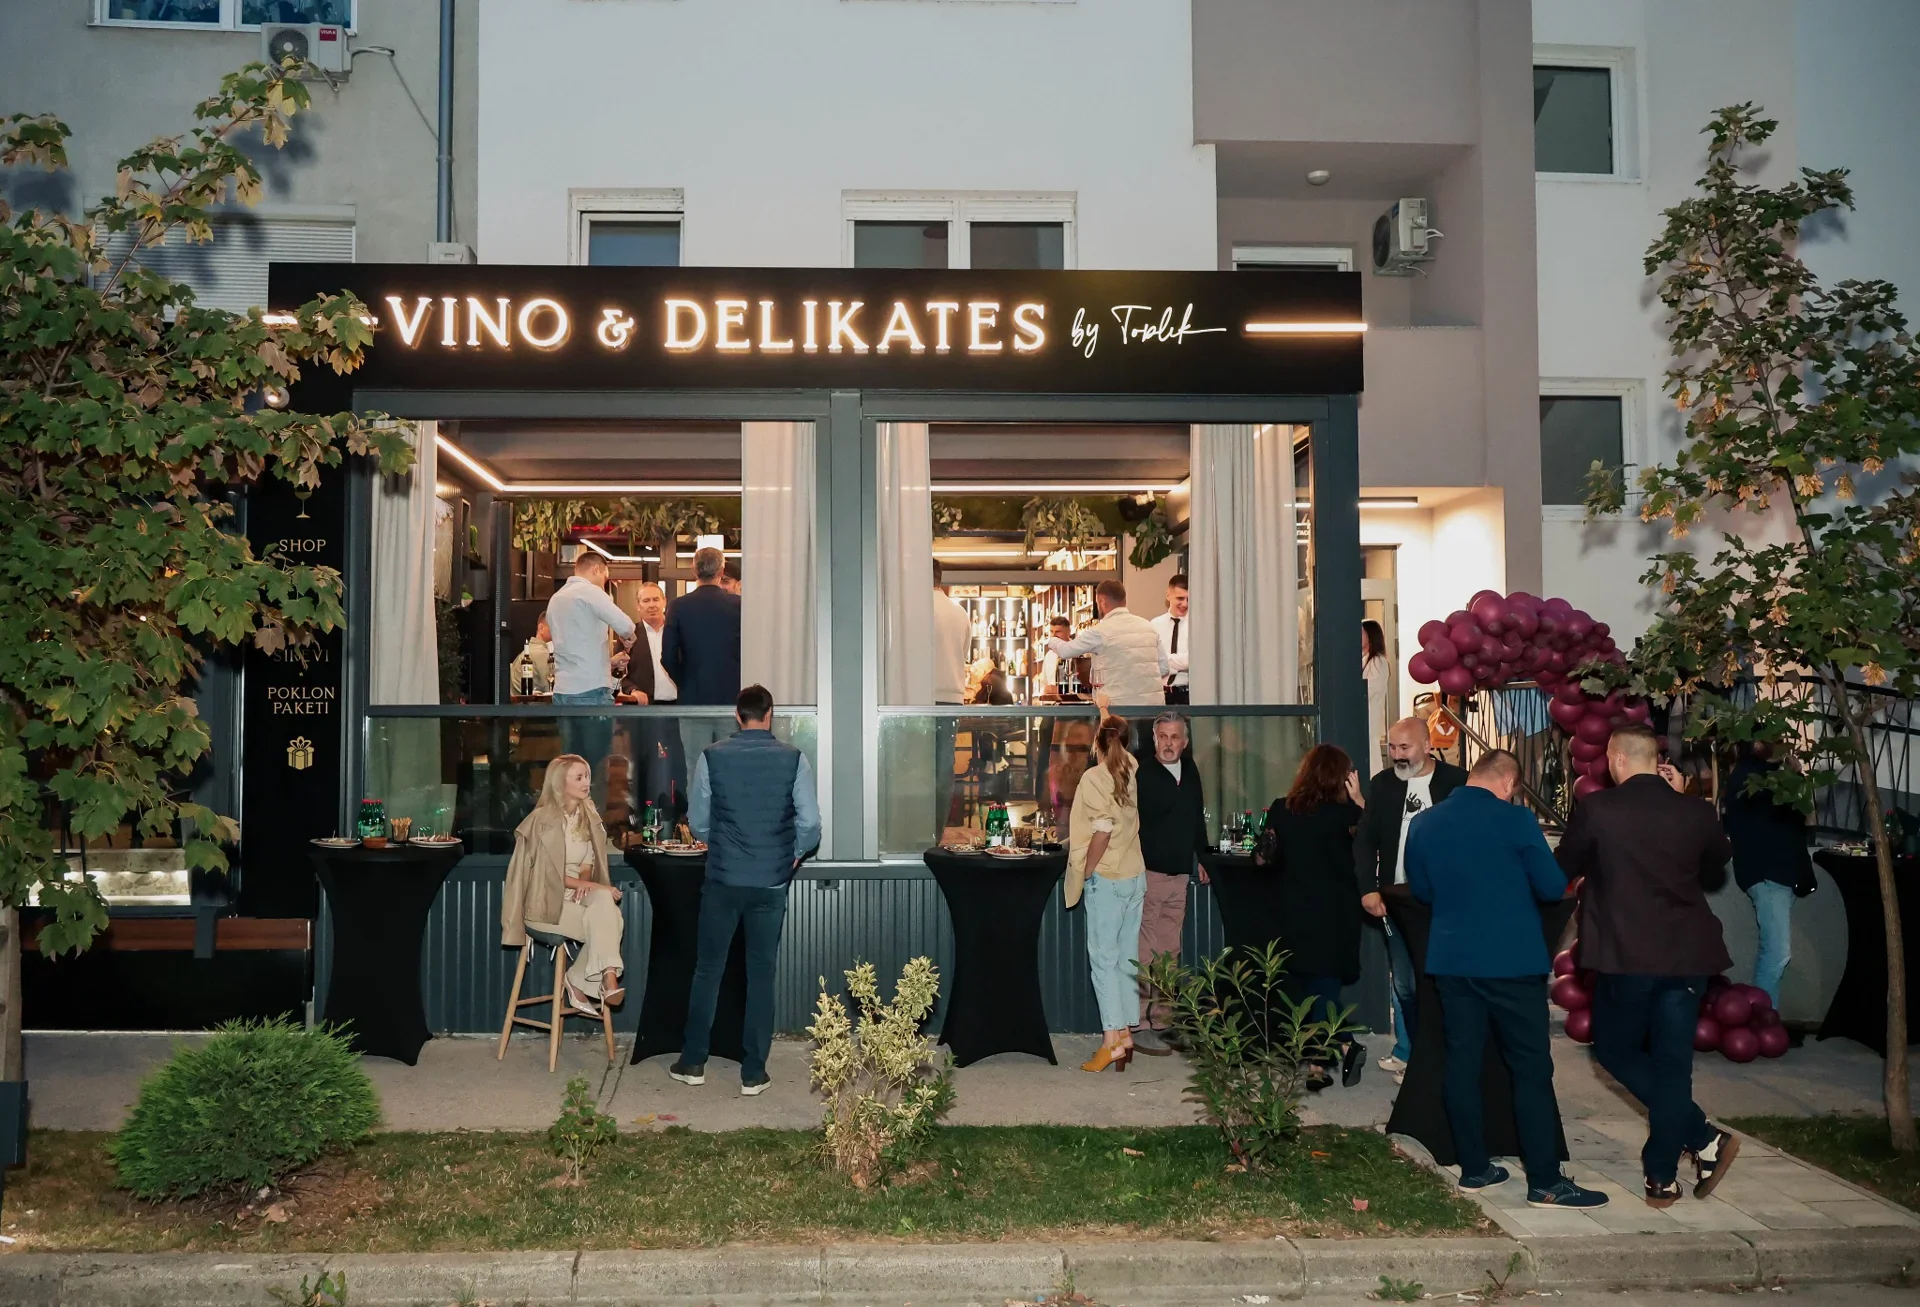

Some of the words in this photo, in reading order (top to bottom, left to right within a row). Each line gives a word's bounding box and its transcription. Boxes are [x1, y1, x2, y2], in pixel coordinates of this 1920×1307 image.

[385, 296, 571, 349] VINO
[597, 309, 635, 349] &
[664, 299, 1046, 353] DELIKATES
[1071, 307, 1100, 359] by
[278, 538, 327, 553] SHOP
[267, 686, 335, 700] POKLON
[273, 701, 330, 715] PAKETI
